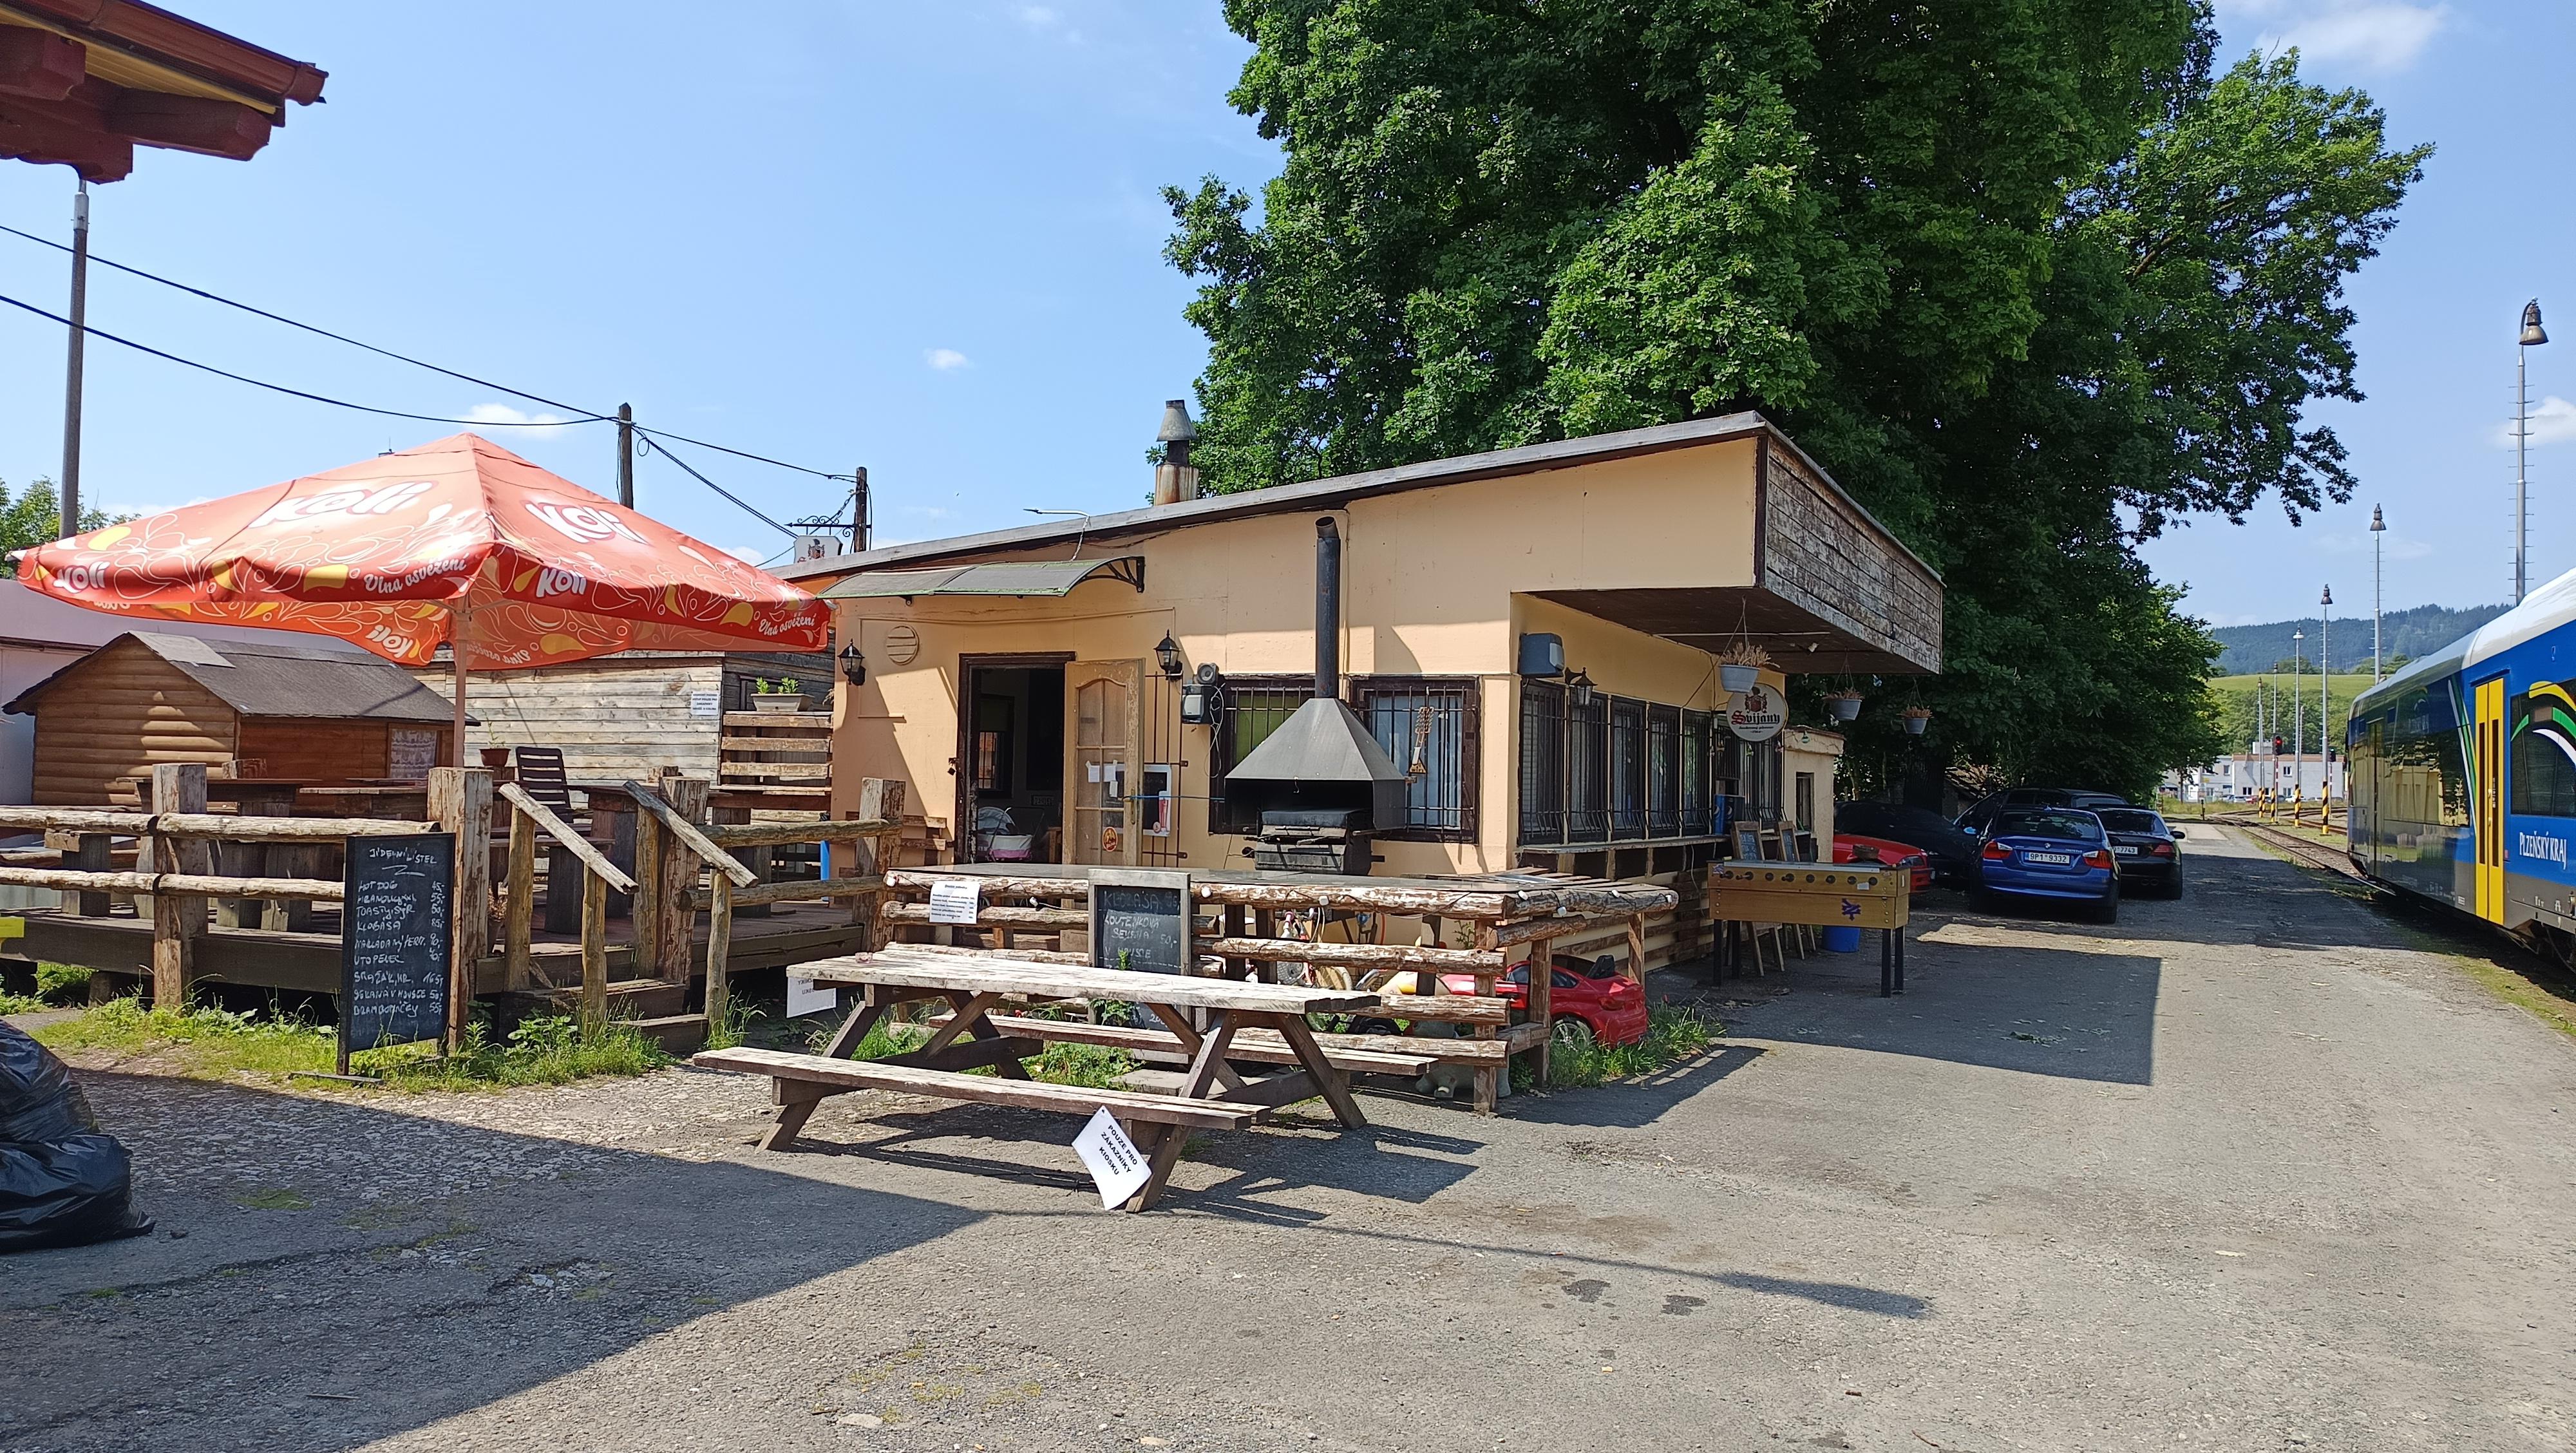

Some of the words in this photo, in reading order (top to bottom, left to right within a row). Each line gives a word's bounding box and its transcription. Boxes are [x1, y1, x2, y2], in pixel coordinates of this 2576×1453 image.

[364, 574, 403, 594] Vlna
[405, 553, 469, 587] osvěžení
[759, 619, 779, 636] Vlna
[779, 613, 817, 632] osvěžení
[1731, 710, 1780, 725] Svijany
[2030, 853, 2043, 861] 9P1
[2519, 830, 2550, 860] PLZEŇSKÝ
[2550, 837, 2567, 870] KRAJ
[358, 880, 376, 893] HOT
[377, 880, 397, 890] DOG
[355, 917, 401, 933] KLOBÁSA
[390, 989, 397, 998] V
[1101, 1131, 1132, 1173] ZÁKAZNÍKY
[1108, 1125, 1127, 1150] POUZE
[1125, 1149, 1137, 1165] PRO
[1099, 1146, 1119, 1175] KIOSKU
